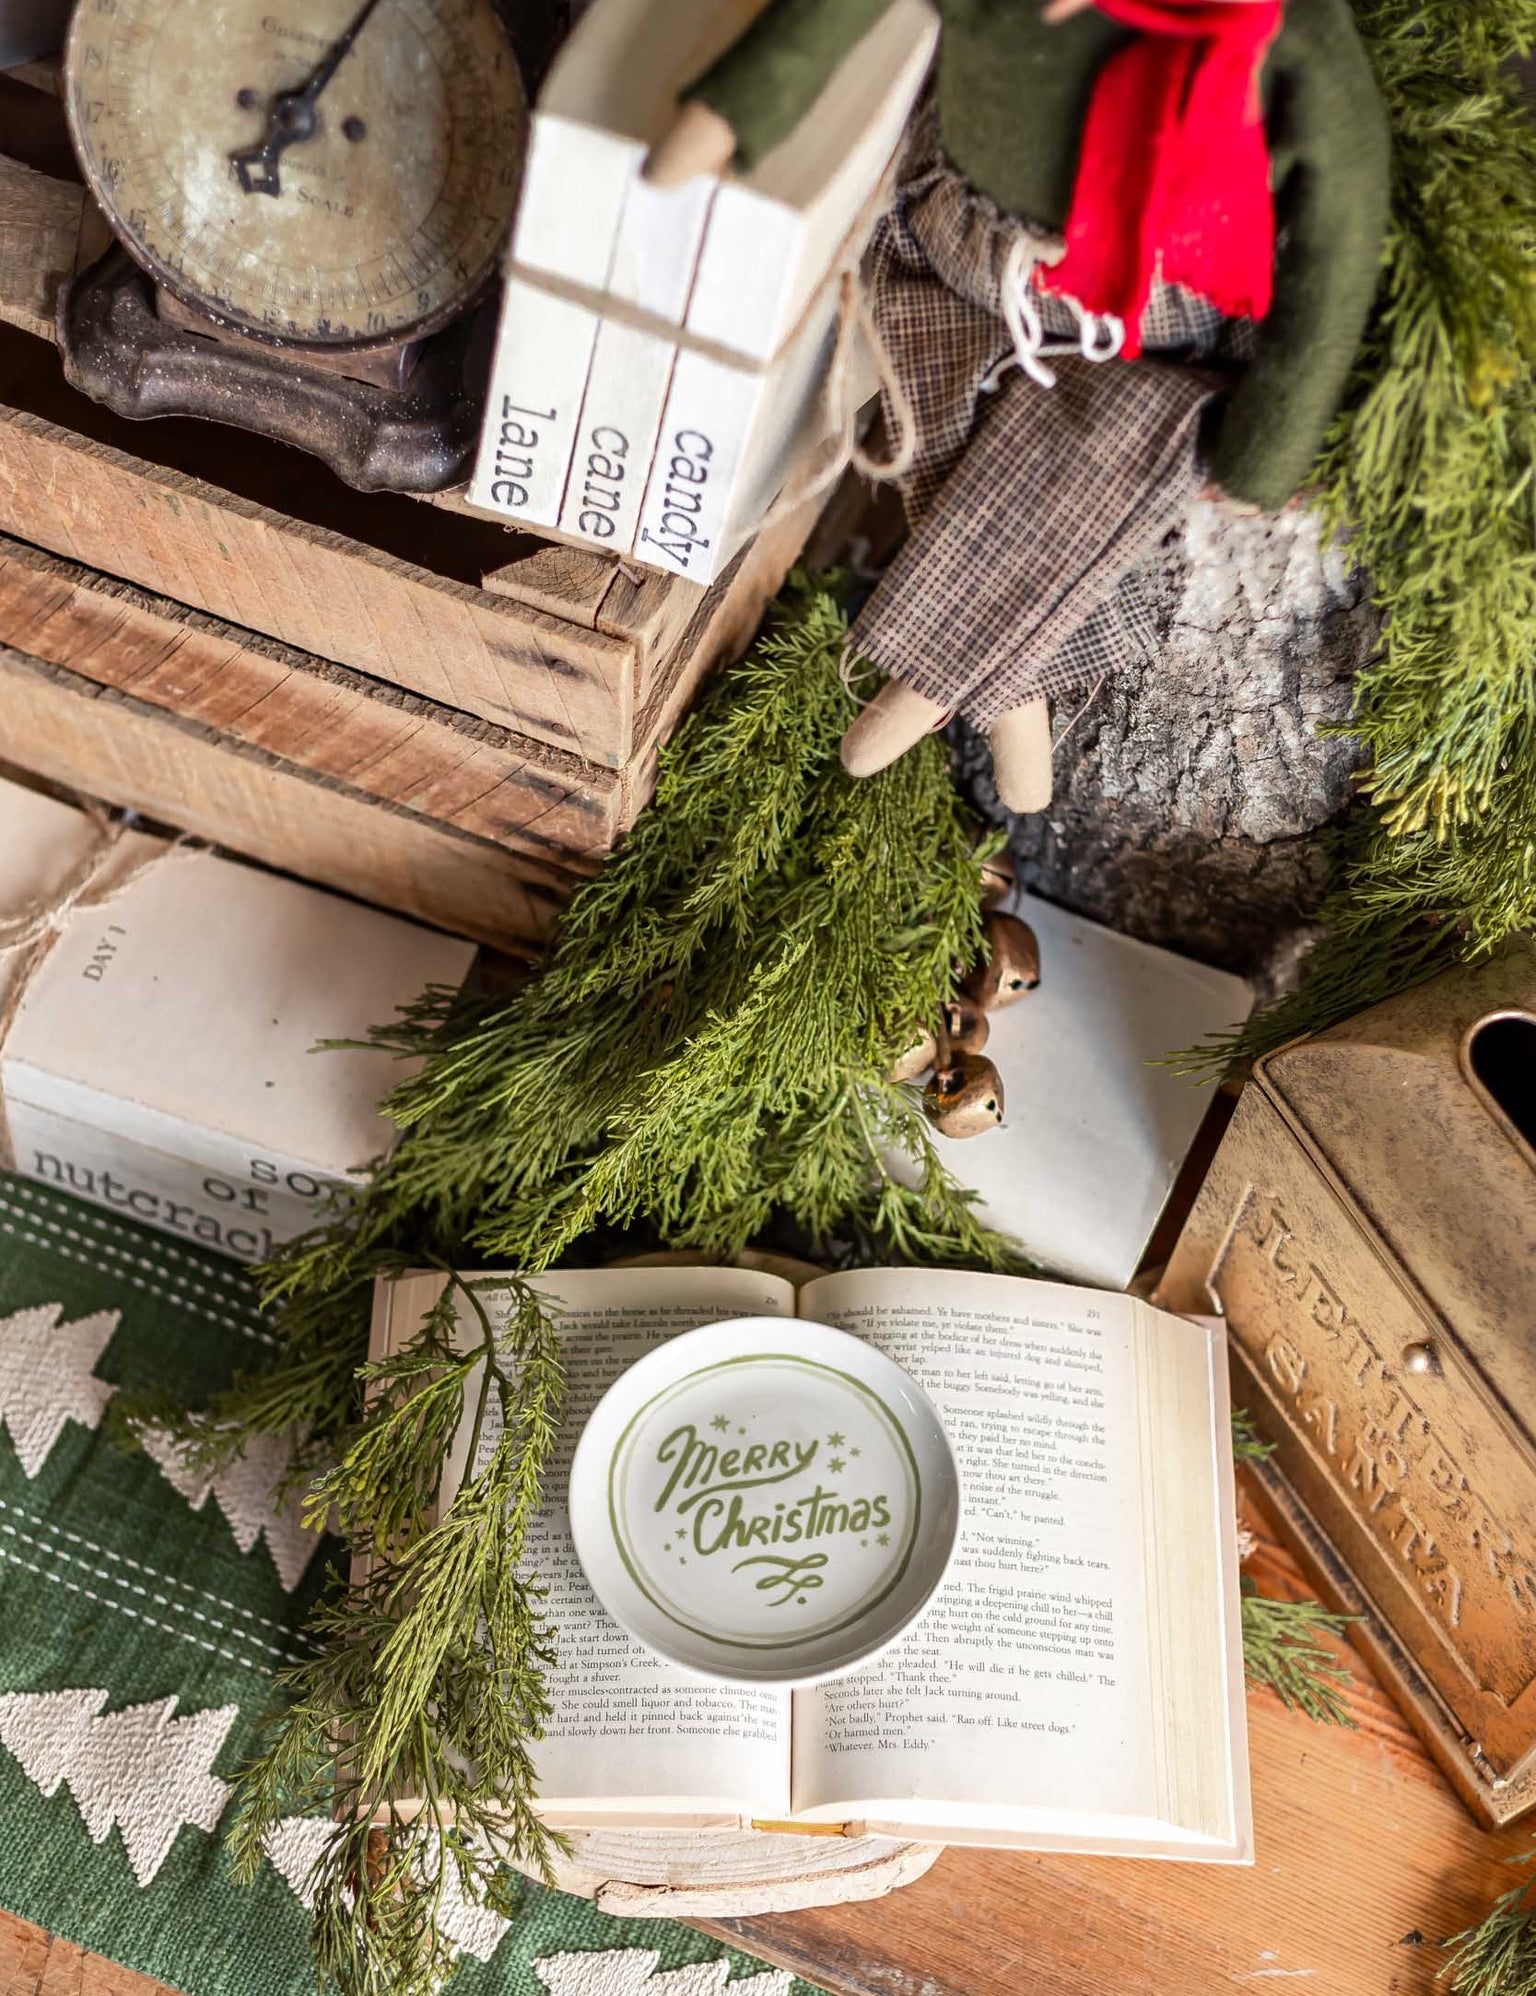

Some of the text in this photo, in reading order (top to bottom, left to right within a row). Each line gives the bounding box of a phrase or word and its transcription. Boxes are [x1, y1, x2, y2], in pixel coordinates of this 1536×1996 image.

[491, 395, 557, 507] lane
[578, 426, 630, 538] cane
[640, 429, 714, 567] candy
[82, 935, 119, 983] DAY
[943, 1404, 984, 1417] Someone
[693, 1485, 891, 1555] Christmas
[982, 1545, 1023, 1561] suddenly
[1026, 1549, 1061, 1566] fighting
[1063, 1554, 1084, 1568] back
[975, 1558, 1018, 1572] thou hurt
[551, 1595, 582, 1605] certain
[585, 1594, 595, 1604] of
[967, 1582, 986, 1595] The
[989, 1584, 1014, 1598] frigid
[1049, 1592, 1072, 1604] wind
[1075, 1595, 1113, 1610] whipped
[568, 1609, 587, 1617] one
[949, 1607, 969, 1619] hurt
[971, 1612, 984, 1620] on
[986, 1609, 1001, 1622] the
[1003, 1611, 1022, 1624] cold
[1024, 1616, 1057, 1630] ground
[1059, 1618, 1073, 1630] for
[1031, 1600, 1050, 1614] chill
[1095, 1609, 1113, 1622] chill
[563, 1620, 592, 1631] want?
[933, 1619, 949, 1630] the
[951, 1621, 985, 1634] weight
[985, 1622, 995, 1634] of
[997, 1627, 1037, 1639] someone
[1039, 1630, 1077, 1645] stepping
[556, 1632, 629, 1645] Jack start down
[924, 1632, 950, 1644] Then
[953, 1632, 994, 1648] abruptly
[997, 1636, 1012, 1649] the
[1016, 1640, 1072, 1655] unconscious
[576, 1645, 629, 1657] had turned
[904, 1646, 919, 1656] the
[569, 1661, 578, 1670] at
[630, 1657, 662, 1669] Creek,
[549, 1672, 621, 1686] fought shiver.
[877, 1659, 894, 1668] she
[968, 1661, 985, 1673] will
[990, 1663, 1004, 1675] die
[1019, 1665, 1030, 1677] he
[1034, 1670, 1052, 1680] gets
[1098, 1675, 1116, 1687] The
[661, 1686, 672, 1695] as
[674, 1686, 717, 1695] someone
[720, 1685, 757, 1698] climbed
[824, 1684, 1021, 1703] Seconds later she felt Jack turning around.
[561, 1697, 758, 1711] She could smell liquor and tobacco. The
[847, 1700, 876, 1711] others
[557, 1710, 703, 1723] hard and held it pinned back
[885, 1711, 923, 1724] Prophet
[997, 1717, 1017, 1729] Like
[1021, 1721, 1045, 1732] street
[567, 1723, 777, 1742] slowly down her front. Someone else grabbed
[844, 1726, 880, 1739] harmed
